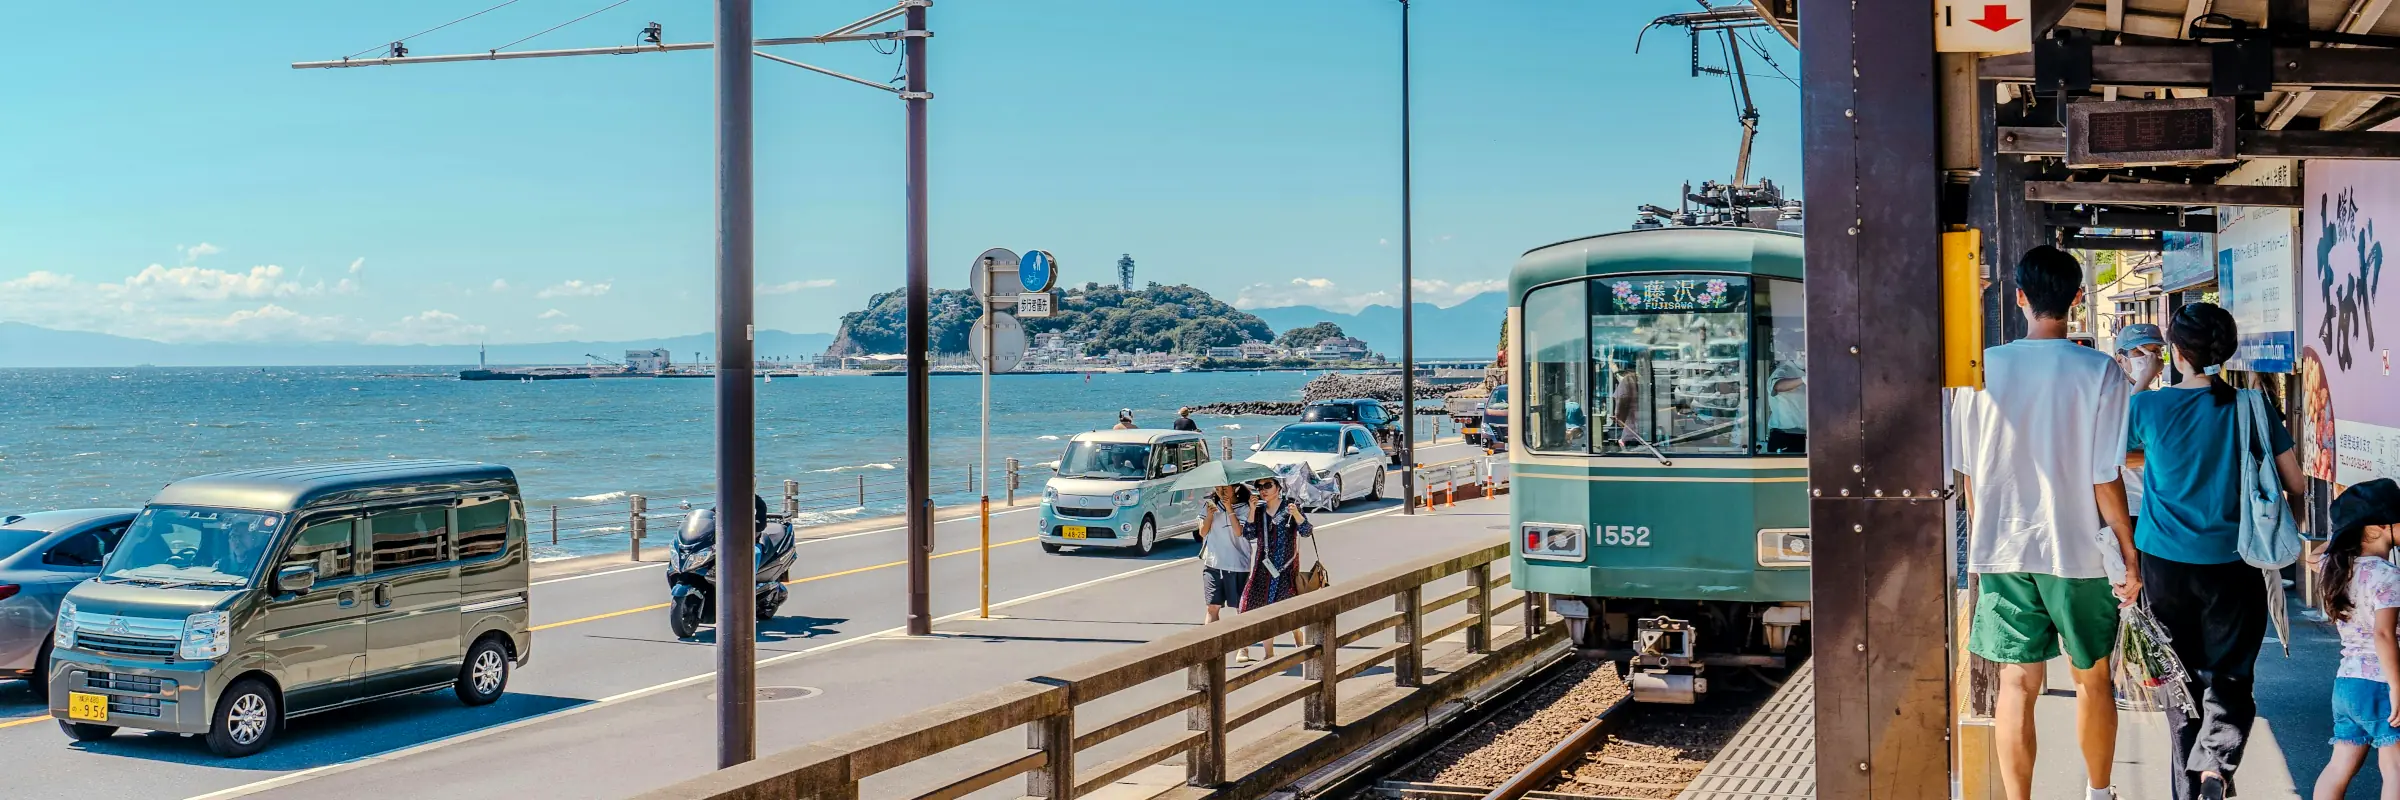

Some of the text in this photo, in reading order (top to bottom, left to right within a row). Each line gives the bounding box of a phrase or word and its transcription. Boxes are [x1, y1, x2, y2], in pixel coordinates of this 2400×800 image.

[1643, 280, 1696, 302] 藤沢
[1021, 298, 1047, 311] 歩行者優先
[1645, 302, 1693, 310] FUJISAWA
[1596, 525, 1650, 546] 1552
